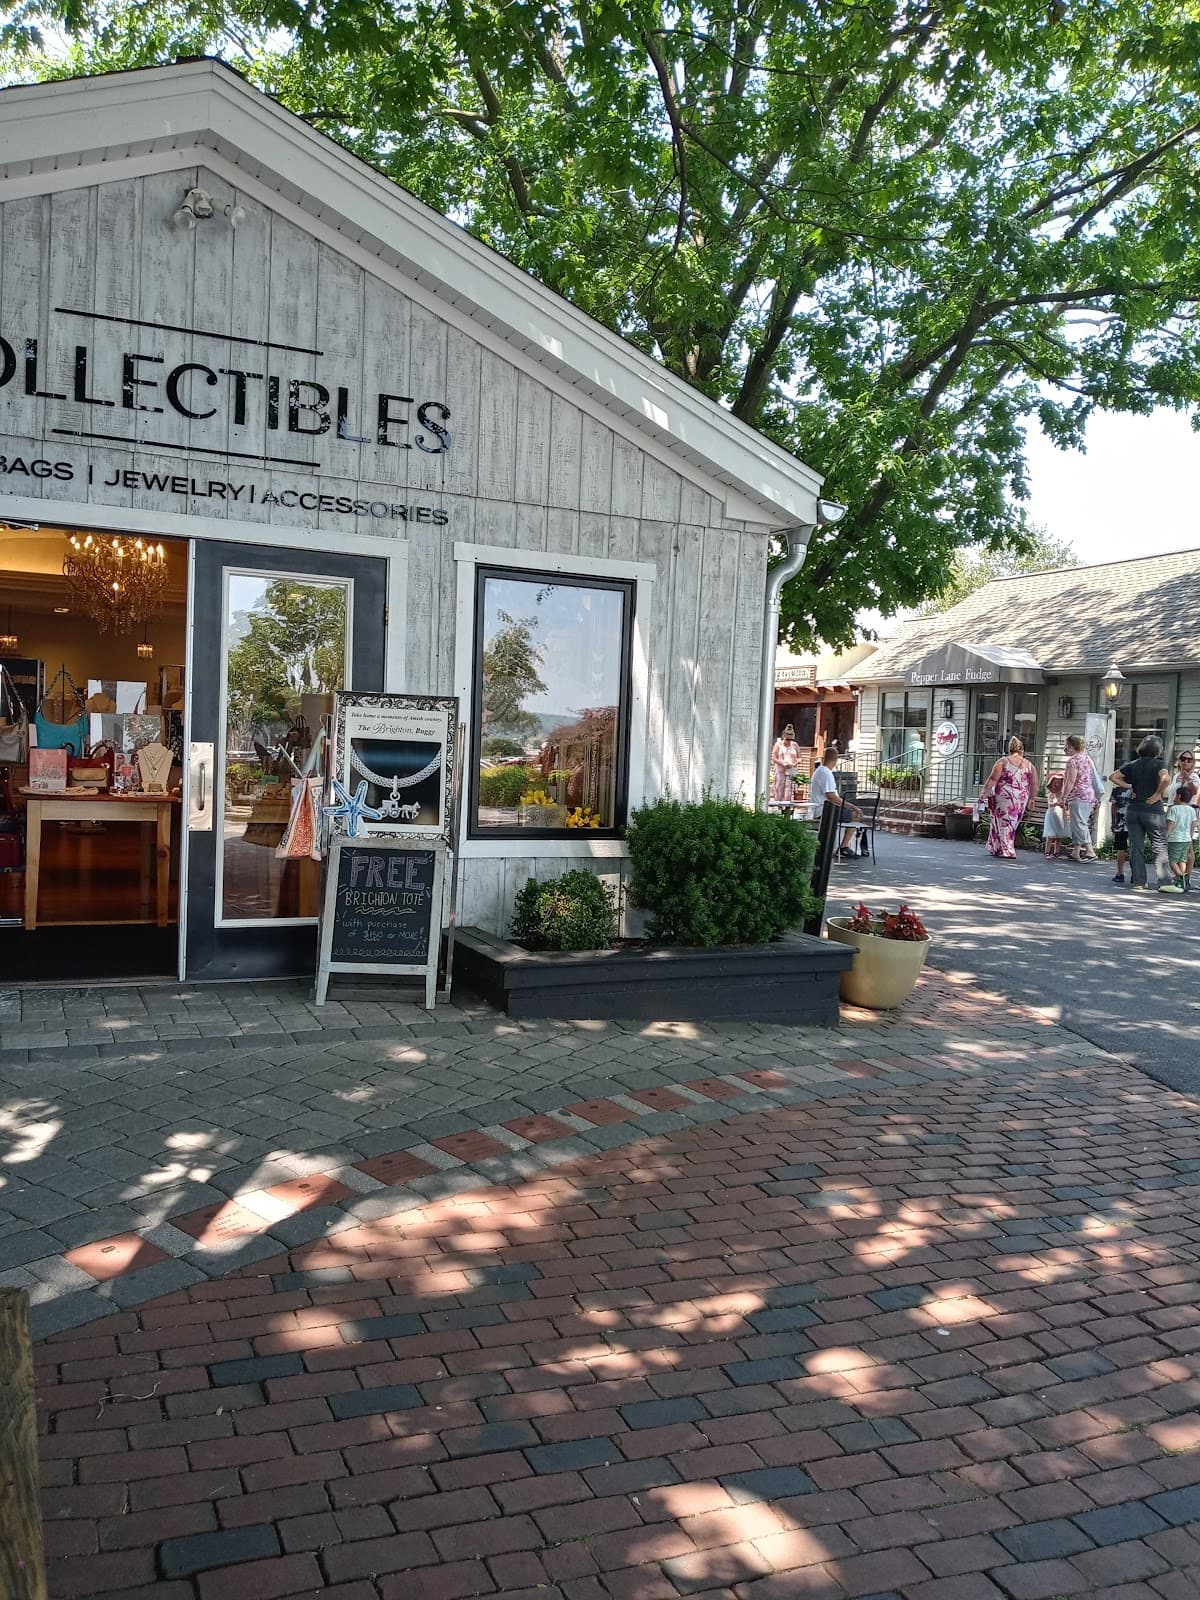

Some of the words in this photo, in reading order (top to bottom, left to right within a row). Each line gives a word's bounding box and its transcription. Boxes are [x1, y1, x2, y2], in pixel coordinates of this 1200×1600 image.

[104, 469, 245, 501] JEWELRY
[262, 490, 449, 526] ACCESSORIES
[911, 671, 938, 686] Pepper
[941, 669, 961, 681] Lane
[965, 667, 992, 682] Fudge
[349, 856, 428, 890] FREE
[401, 892, 424, 905] TOTE
[342, 919, 363, 927] with
[367, 920, 408, 930] purchase
